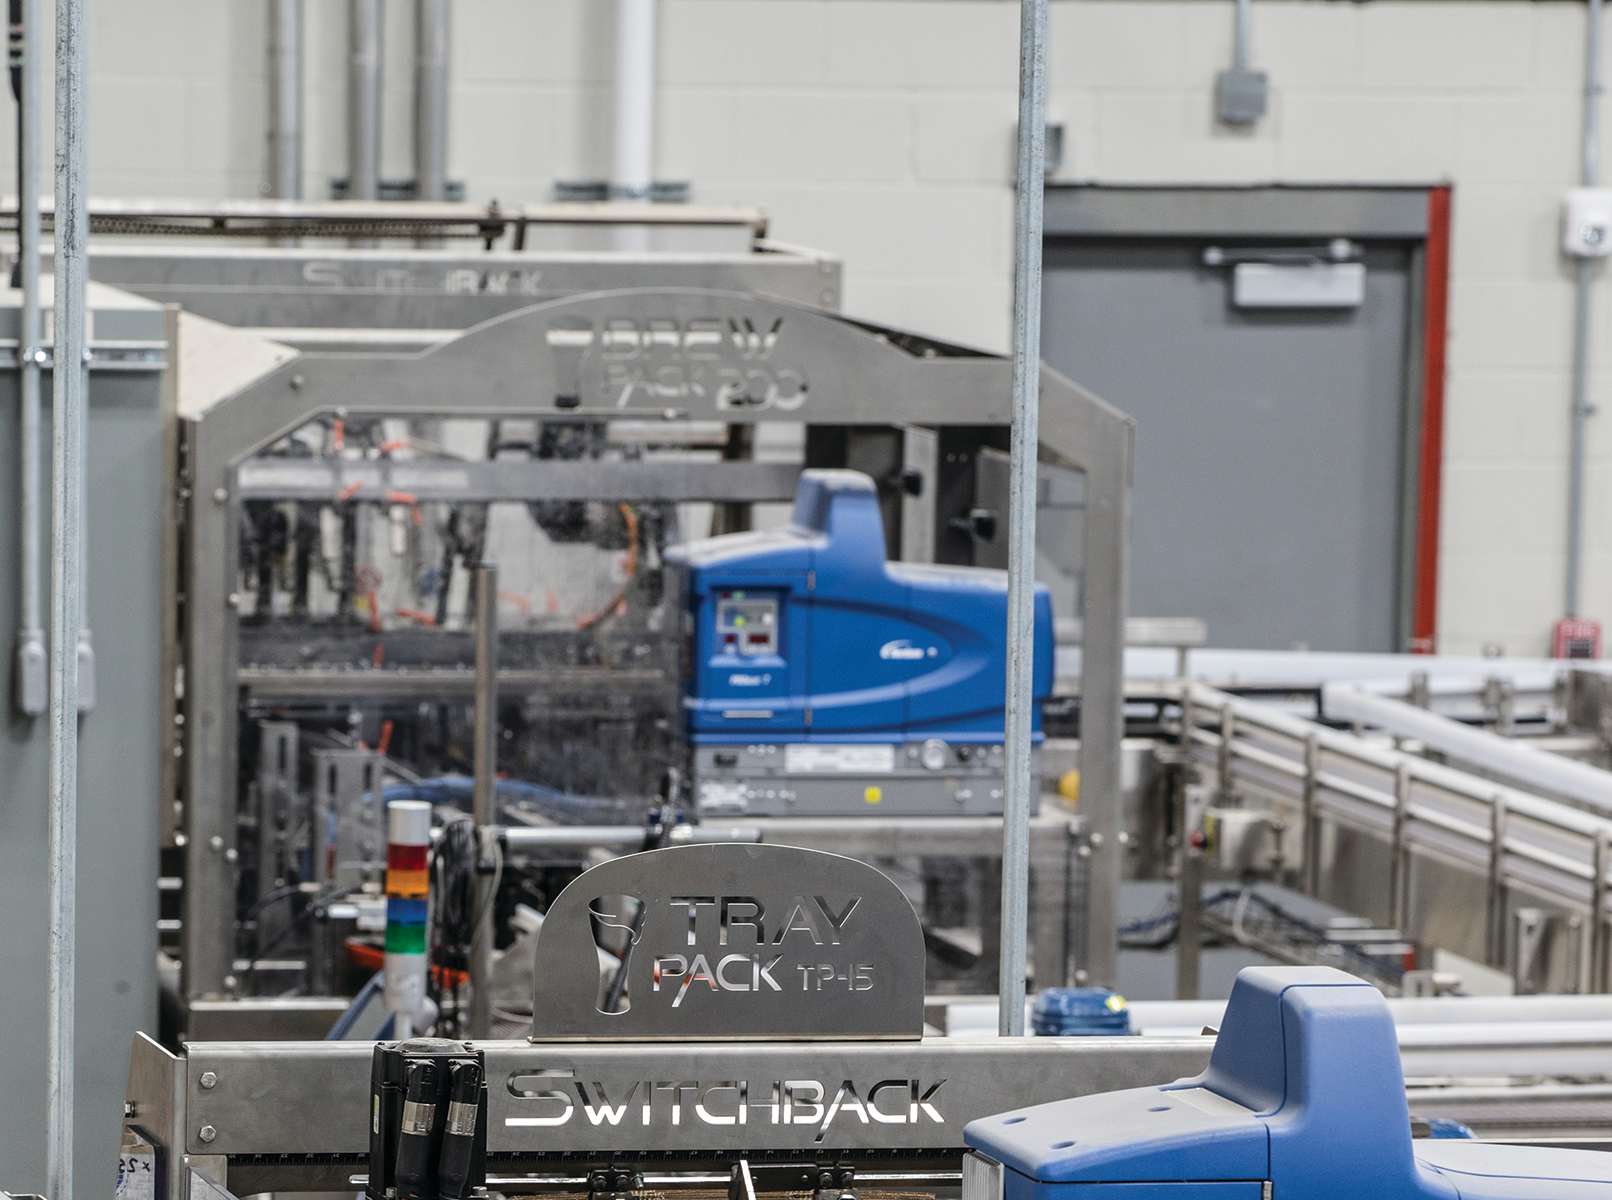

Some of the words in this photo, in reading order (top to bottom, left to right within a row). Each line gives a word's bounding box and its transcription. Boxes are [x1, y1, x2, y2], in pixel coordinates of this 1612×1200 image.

[602, 318, 783, 360] BREW
[670, 895, 864, 946] TRAY
[653, 953, 785, 1008] PACK
[797, 963, 875, 991] TP-15
[504, 1068, 947, 1144] SWITCHBACK
